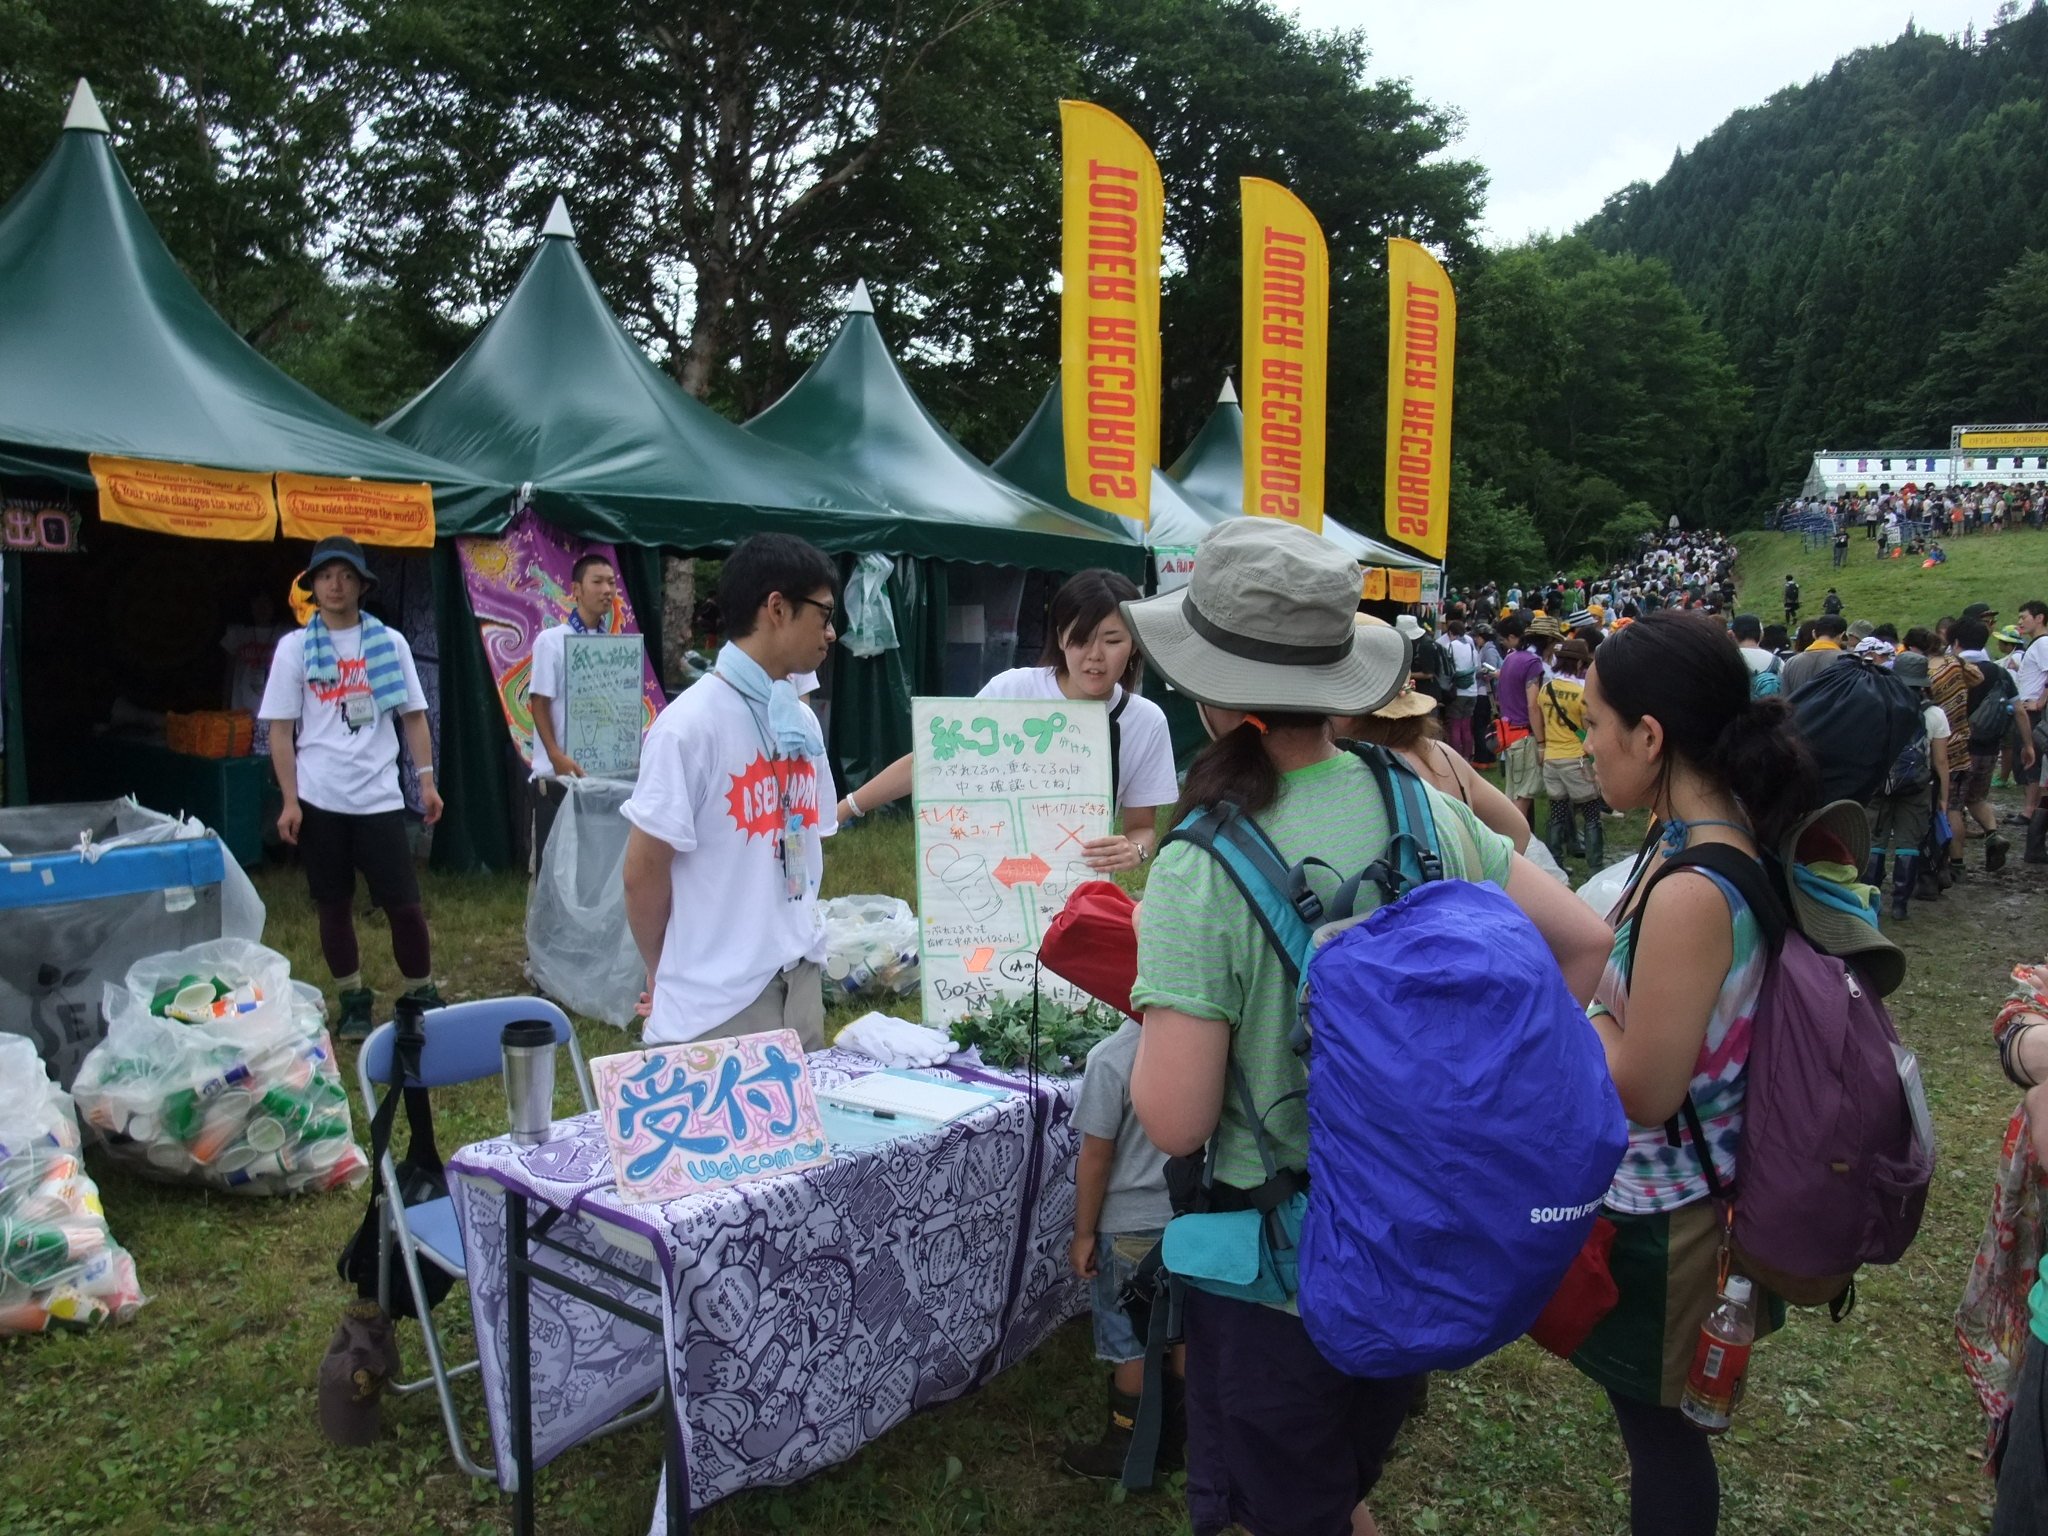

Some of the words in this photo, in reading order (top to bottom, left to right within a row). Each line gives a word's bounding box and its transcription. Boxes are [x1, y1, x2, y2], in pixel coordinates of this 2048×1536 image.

[120, 484, 143, 499] Your
[145, 490, 171, 505] voice
[171, 492, 210, 512] changes
[210, 495, 227, 510] the
[301, 500, 320, 513] Your
[321, 504, 344, 515] voice
[344, 505, 378, 521] changes
[379, 506, 393, 520] the
[6, 511, 70, 548] 出口
[930, 712, 1067, 761] 紙コップ
[917, 805, 969, 826] キレイな
[950, 821, 1006, 841] 紙コップ
[617, 1045, 802, 1181] 受付
[1530, 1204, 1583, 1224] SOUTH
